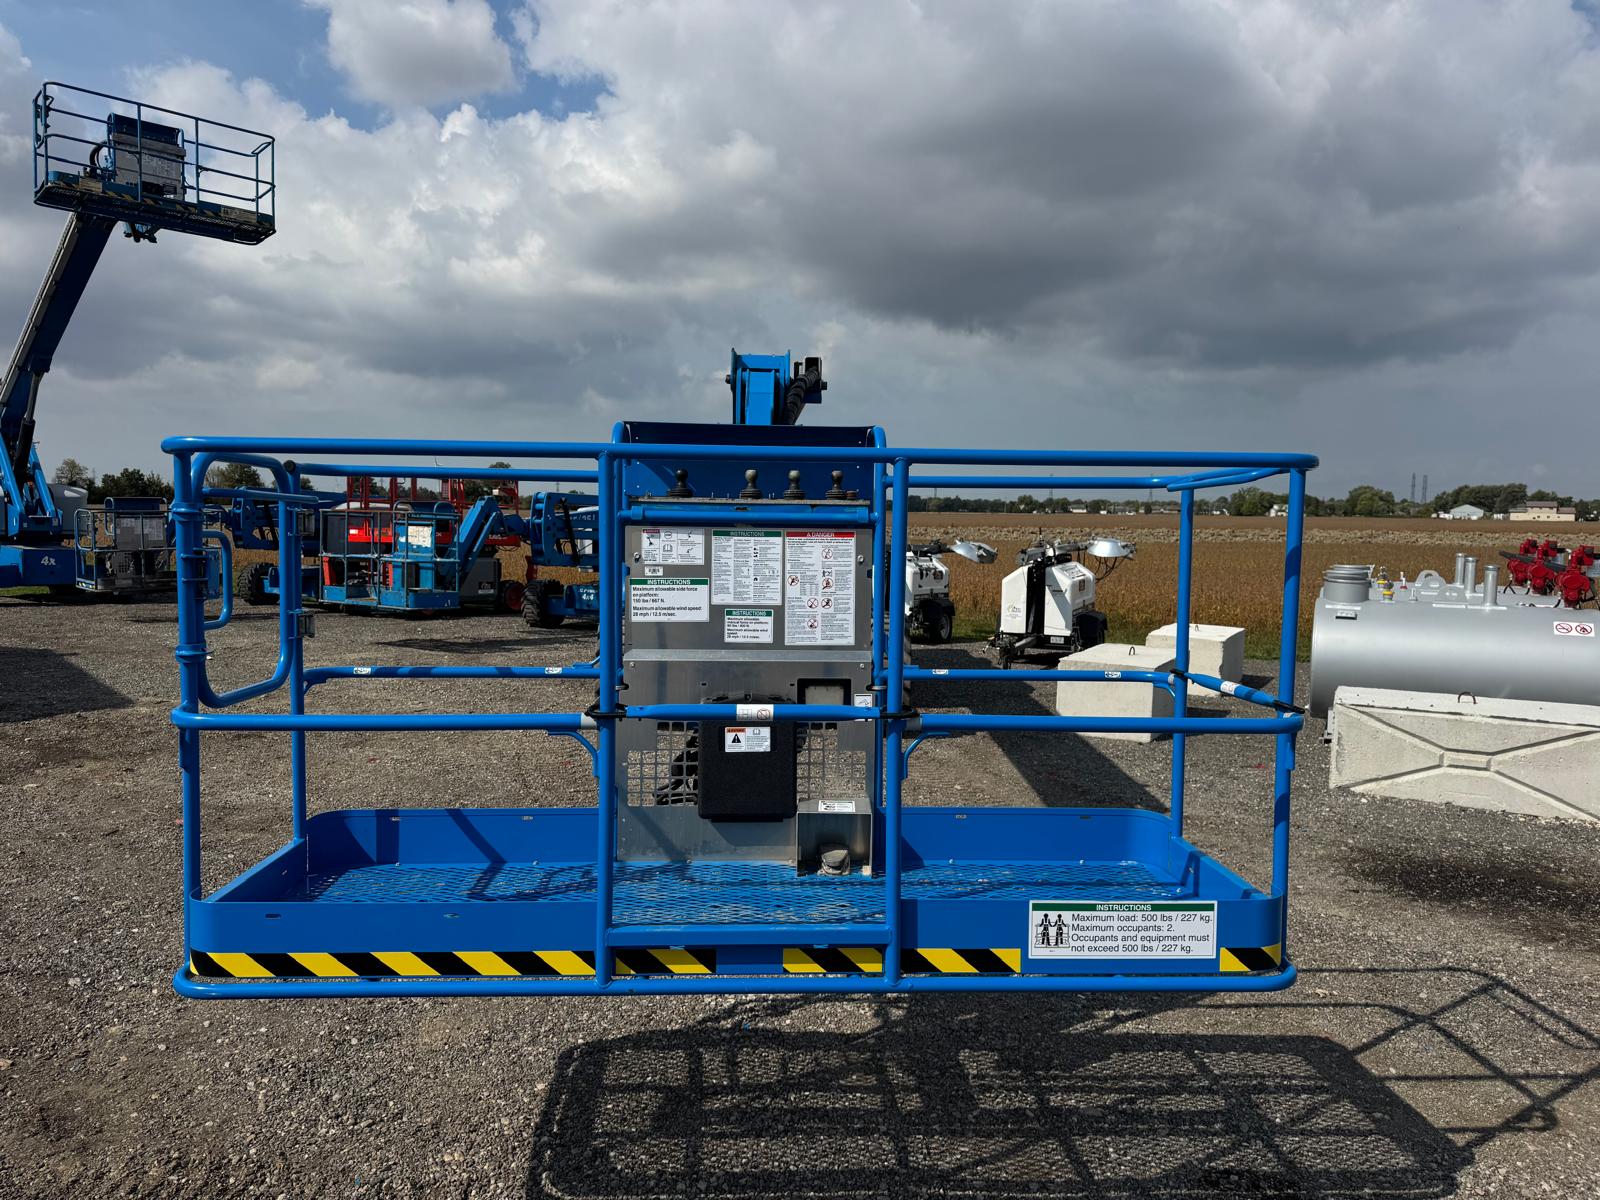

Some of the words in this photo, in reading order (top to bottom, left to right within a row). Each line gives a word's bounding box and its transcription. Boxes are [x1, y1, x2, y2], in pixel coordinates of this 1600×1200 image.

[1071, 914, 1114, 922] Maximum
[1117, 914, 1138, 922] load:
[1141, 914, 1157, 922] 500
[1160, 914, 1173, 922] lbs
[1180, 914, 1197, 922] 227
[1200, 914, 1212, 923] kg.
[1117, 924, 1164, 933] occupants:
[1071, 934, 1118, 943] Occupants
[1140, 934, 1186, 943] equipment
[1088, 944, 1119, 952] exceed
[1122, 944, 1138, 952] 500
[1141, 944, 1154, 952] lbs
[1161, 944, 1178, 952] 227
[1180, 944, 1193, 954] kg.
